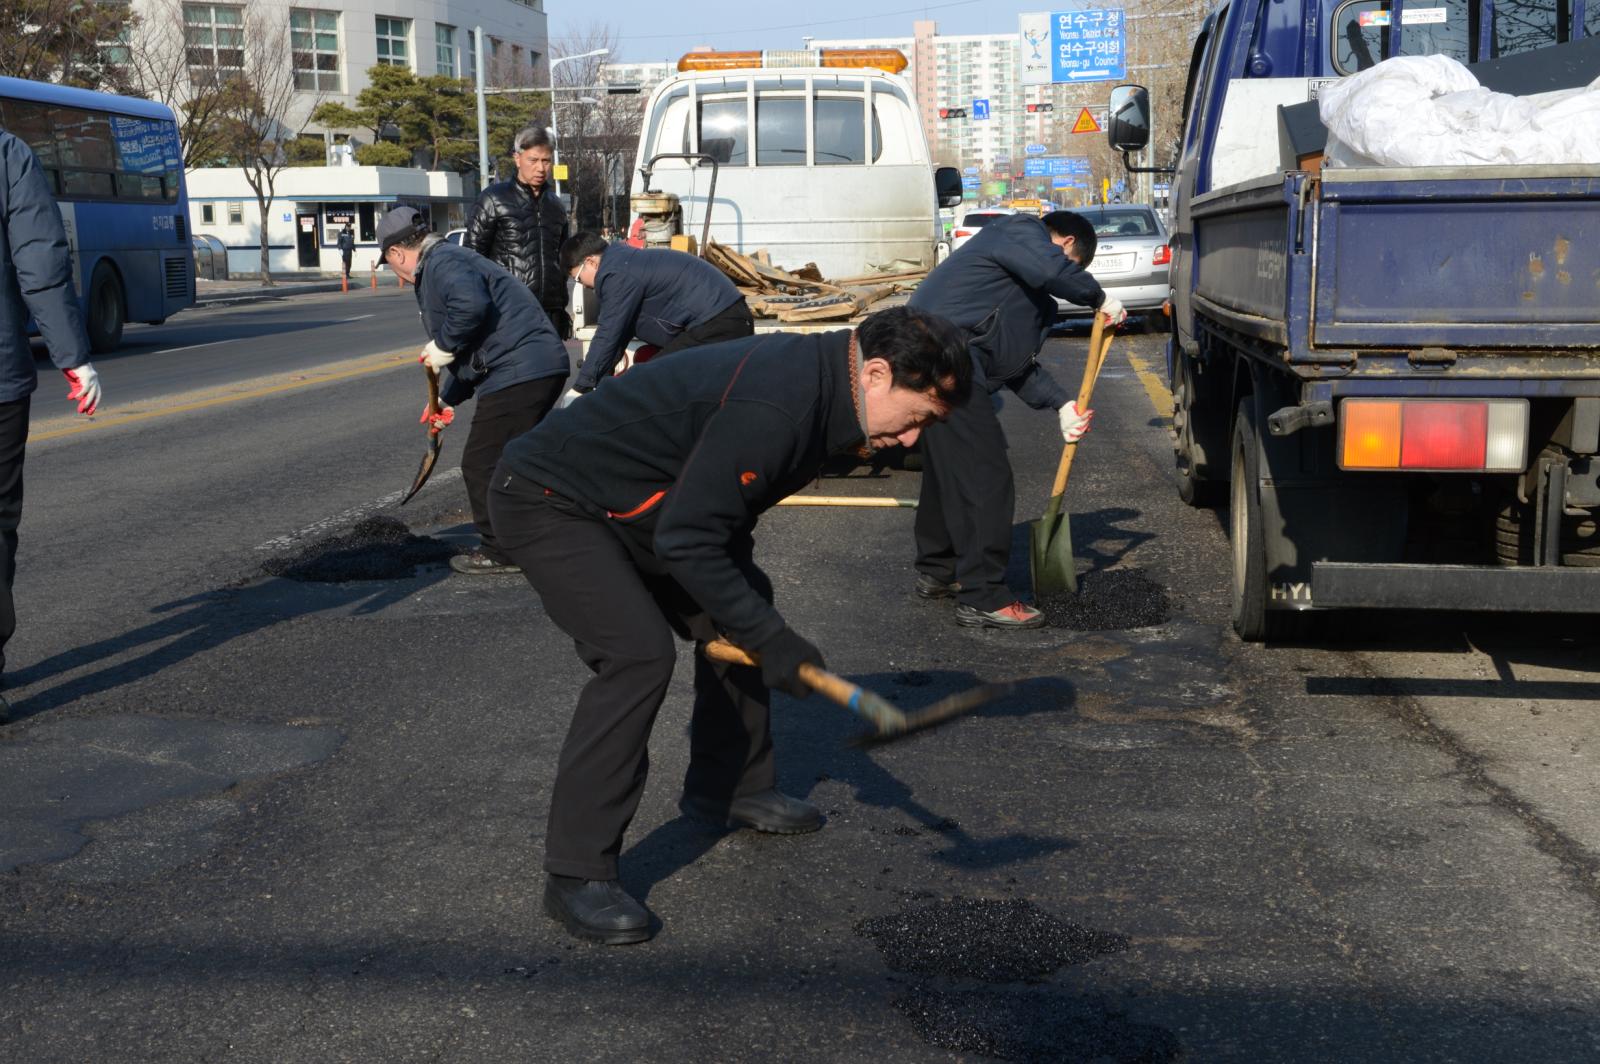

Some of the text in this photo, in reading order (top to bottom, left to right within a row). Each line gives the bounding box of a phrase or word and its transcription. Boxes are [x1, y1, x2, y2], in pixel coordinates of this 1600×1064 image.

[1059, 12, 1118, 29] 연수구청
[1059, 30, 1080, 40] Yeonsu
[1083, 28, 1101, 39] District
[1060, 40, 1120, 58] 연수구의회
[1094, 56, 1118, 67] Council
